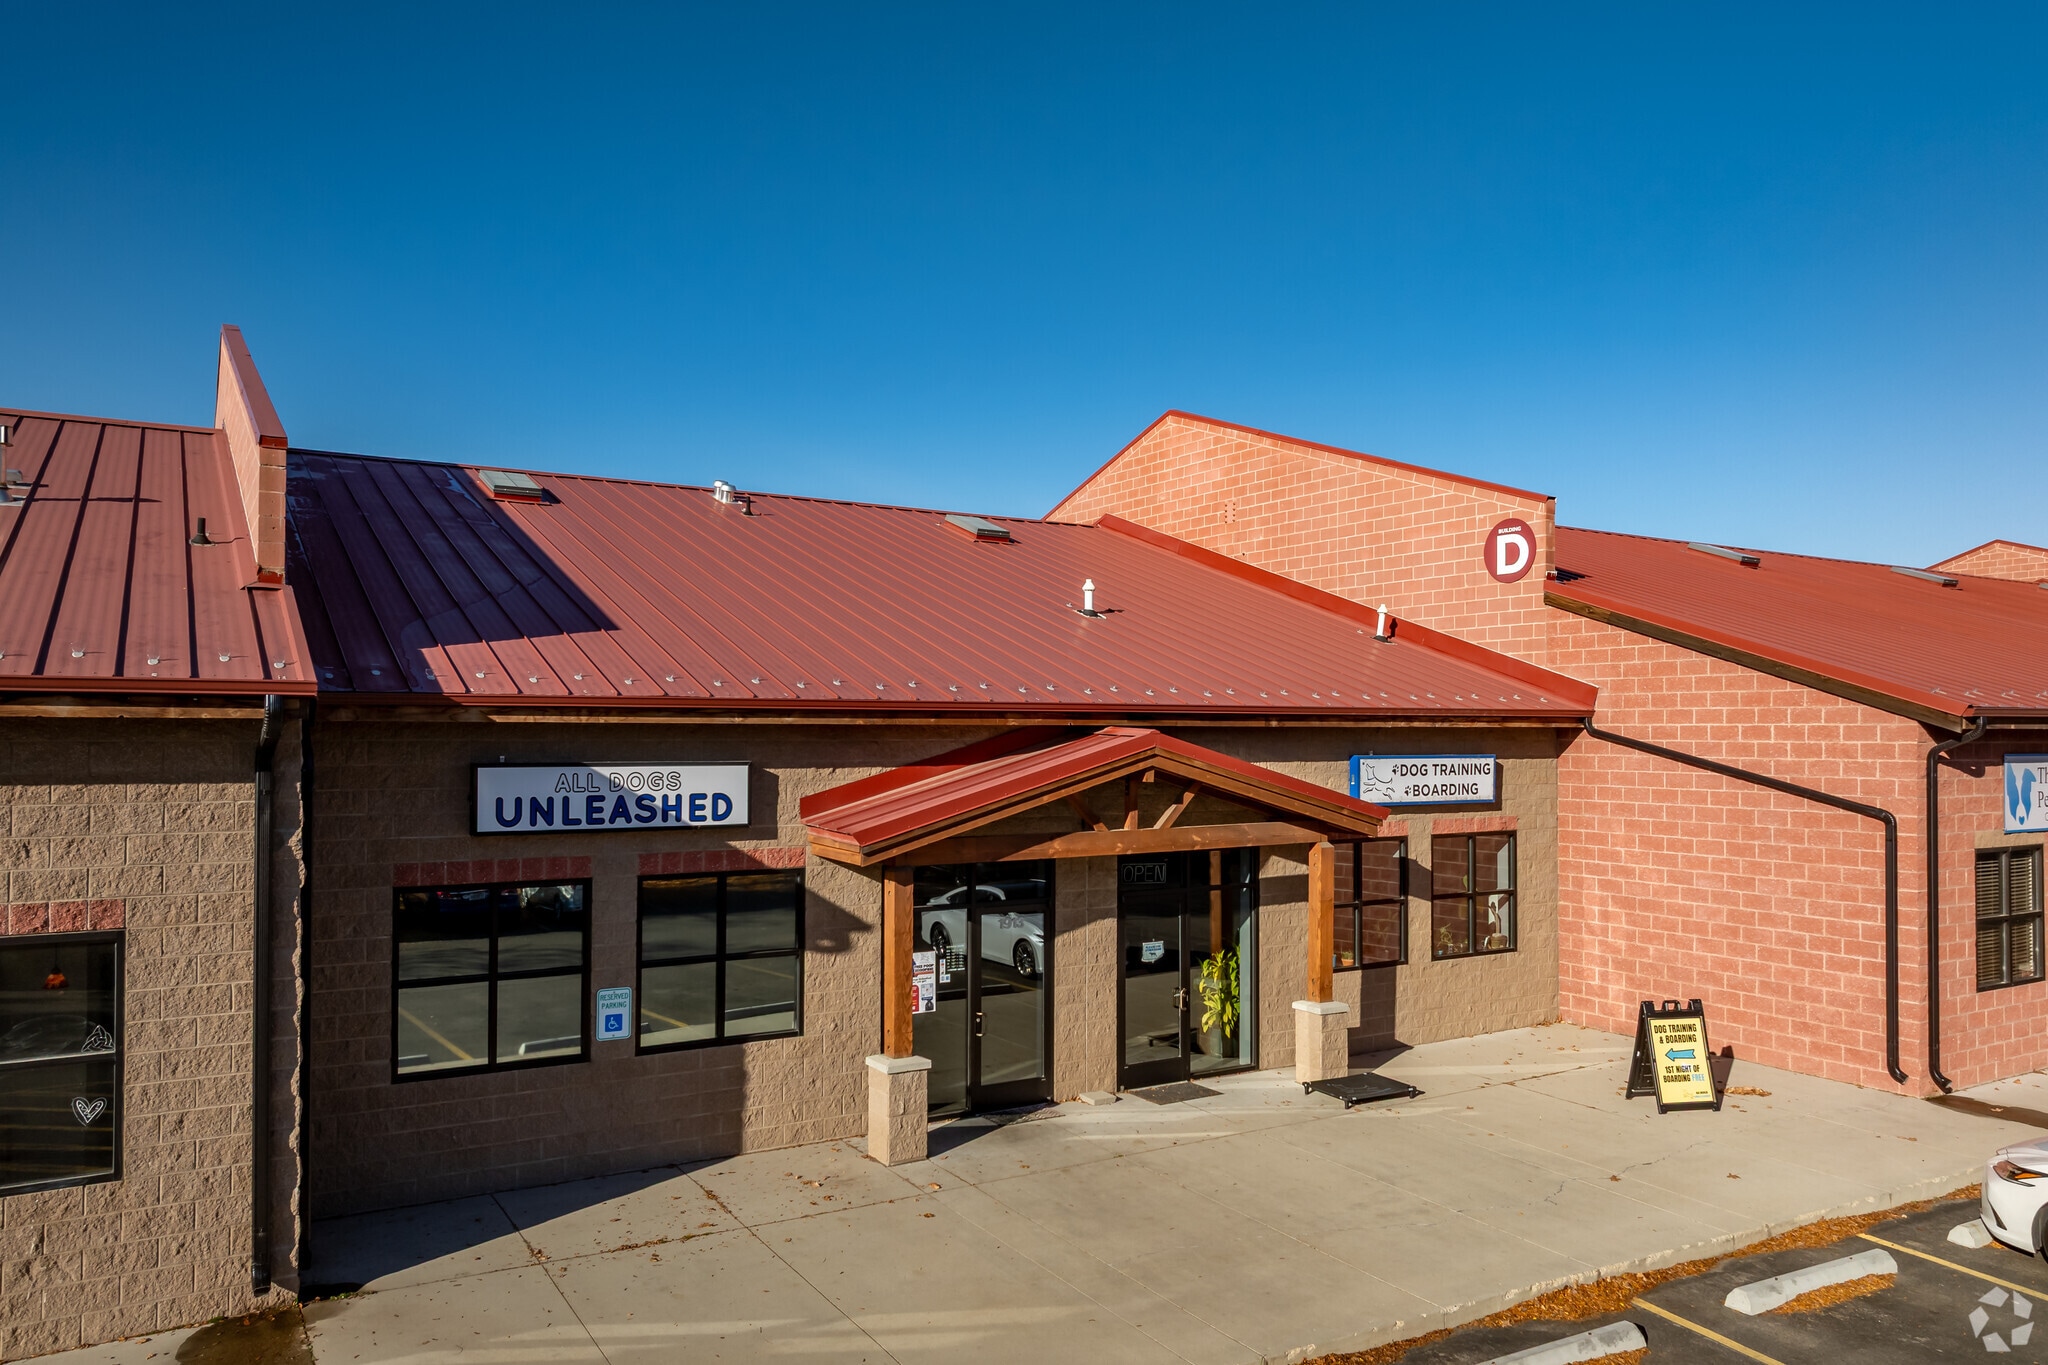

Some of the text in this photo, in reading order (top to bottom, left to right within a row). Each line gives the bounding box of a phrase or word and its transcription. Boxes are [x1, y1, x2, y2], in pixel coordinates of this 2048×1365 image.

[1498, 526, 1522, 534] BUILDING
[1496, 533, 1529, 575] D
[1400, 763, 1491, 777] DOG TRAINING
[555, 771, 682, 793] ALL DOGS
[1412, 783, 1479, 797] BOARDING
[495, 792, 733, 828] UNLEASHED
[1123, 865, 1165, 882] OPEN
[600, 992, 629, 1001] RESERVED
[601, 1001, 627, 1009] PARKING
[1653, 1023, 1697, 1034] DOG TRAINING
[1659, 1034, 1697, 1044] & BOARDING
[1675, 1065, 1692, 1073] NIGHT
[1692, 1064, 1700, 1072] OF
[1663, 1073, 1705, 1083] BOARDING FREE
